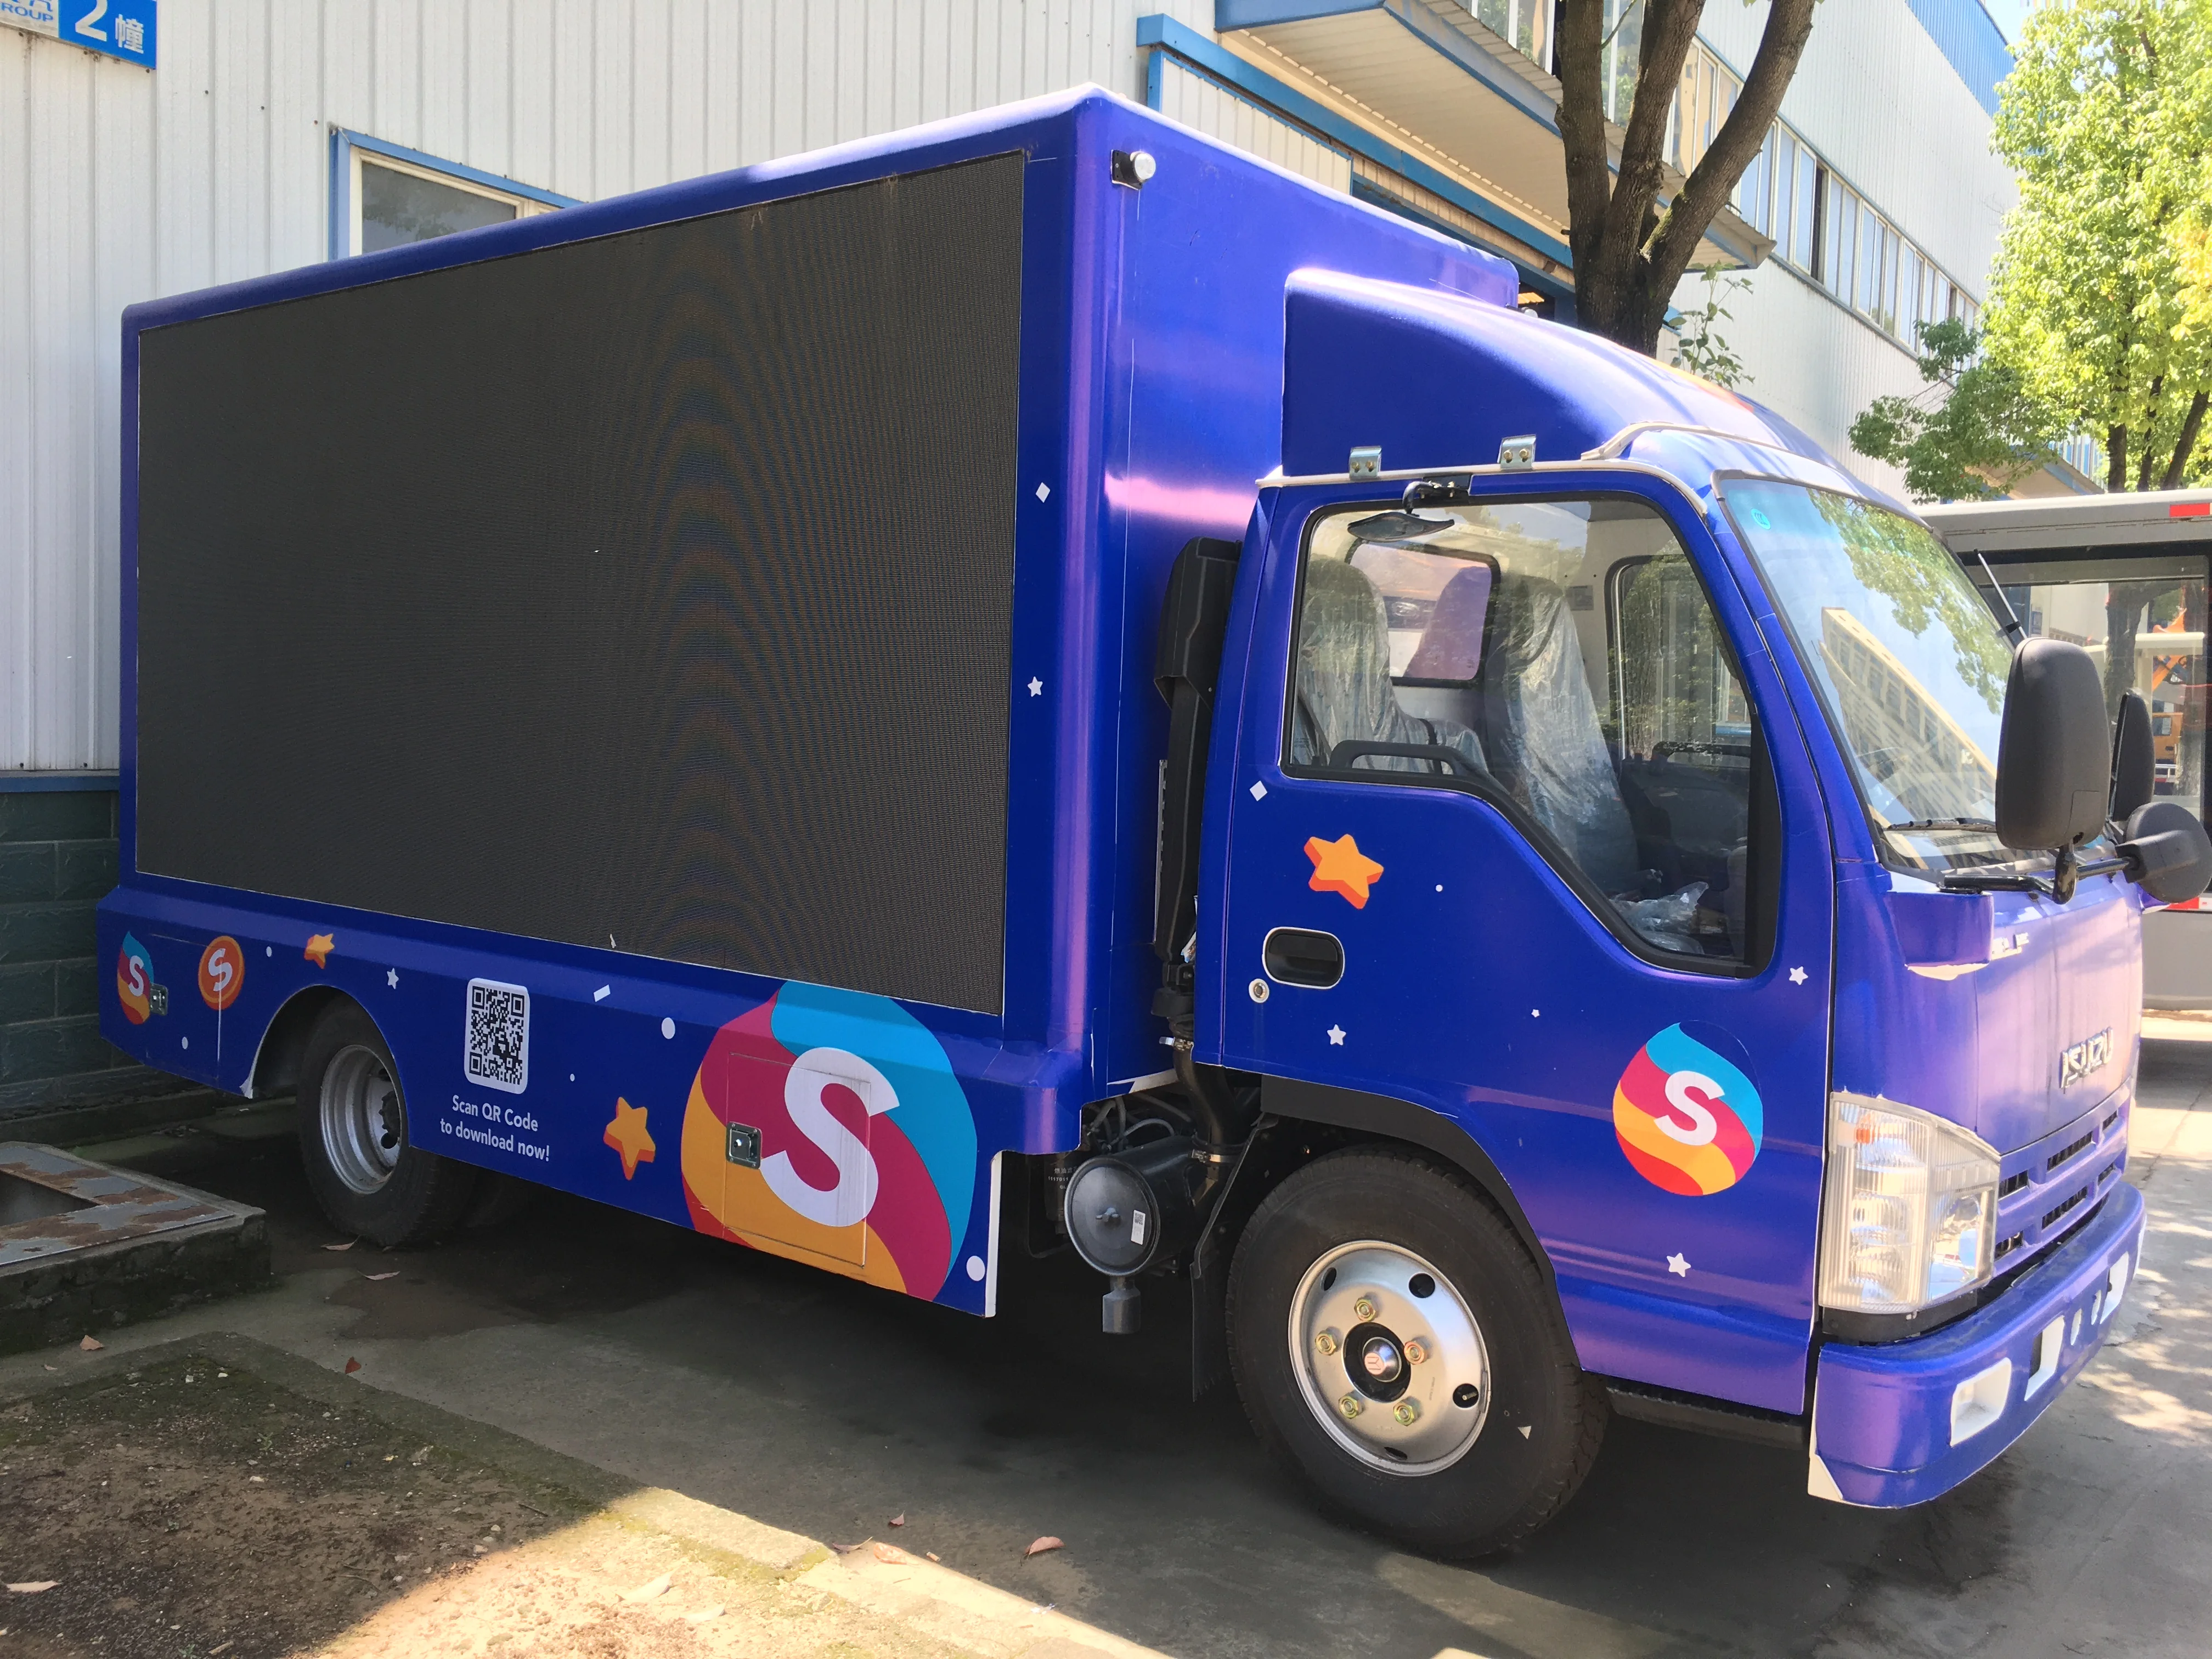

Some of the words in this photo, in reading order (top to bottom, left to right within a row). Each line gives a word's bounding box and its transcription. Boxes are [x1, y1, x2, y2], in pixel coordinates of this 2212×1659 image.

[128, 955, 144, 997] S
[2058, 1026, 2114, 1088] ISUZU
[452, 1094, 478, 1116] Scan
[482, 1103, 501, 1122] QR
[505, 1108, 538, 1132] Code
[1654, 1070, 1725, 1146] S
[440, 1118, 452, 1135] to
[455, 1121, 514, 1152] download
[518, 1145, 549, 1162] now!
[759, 1047, 900, 1227] S
